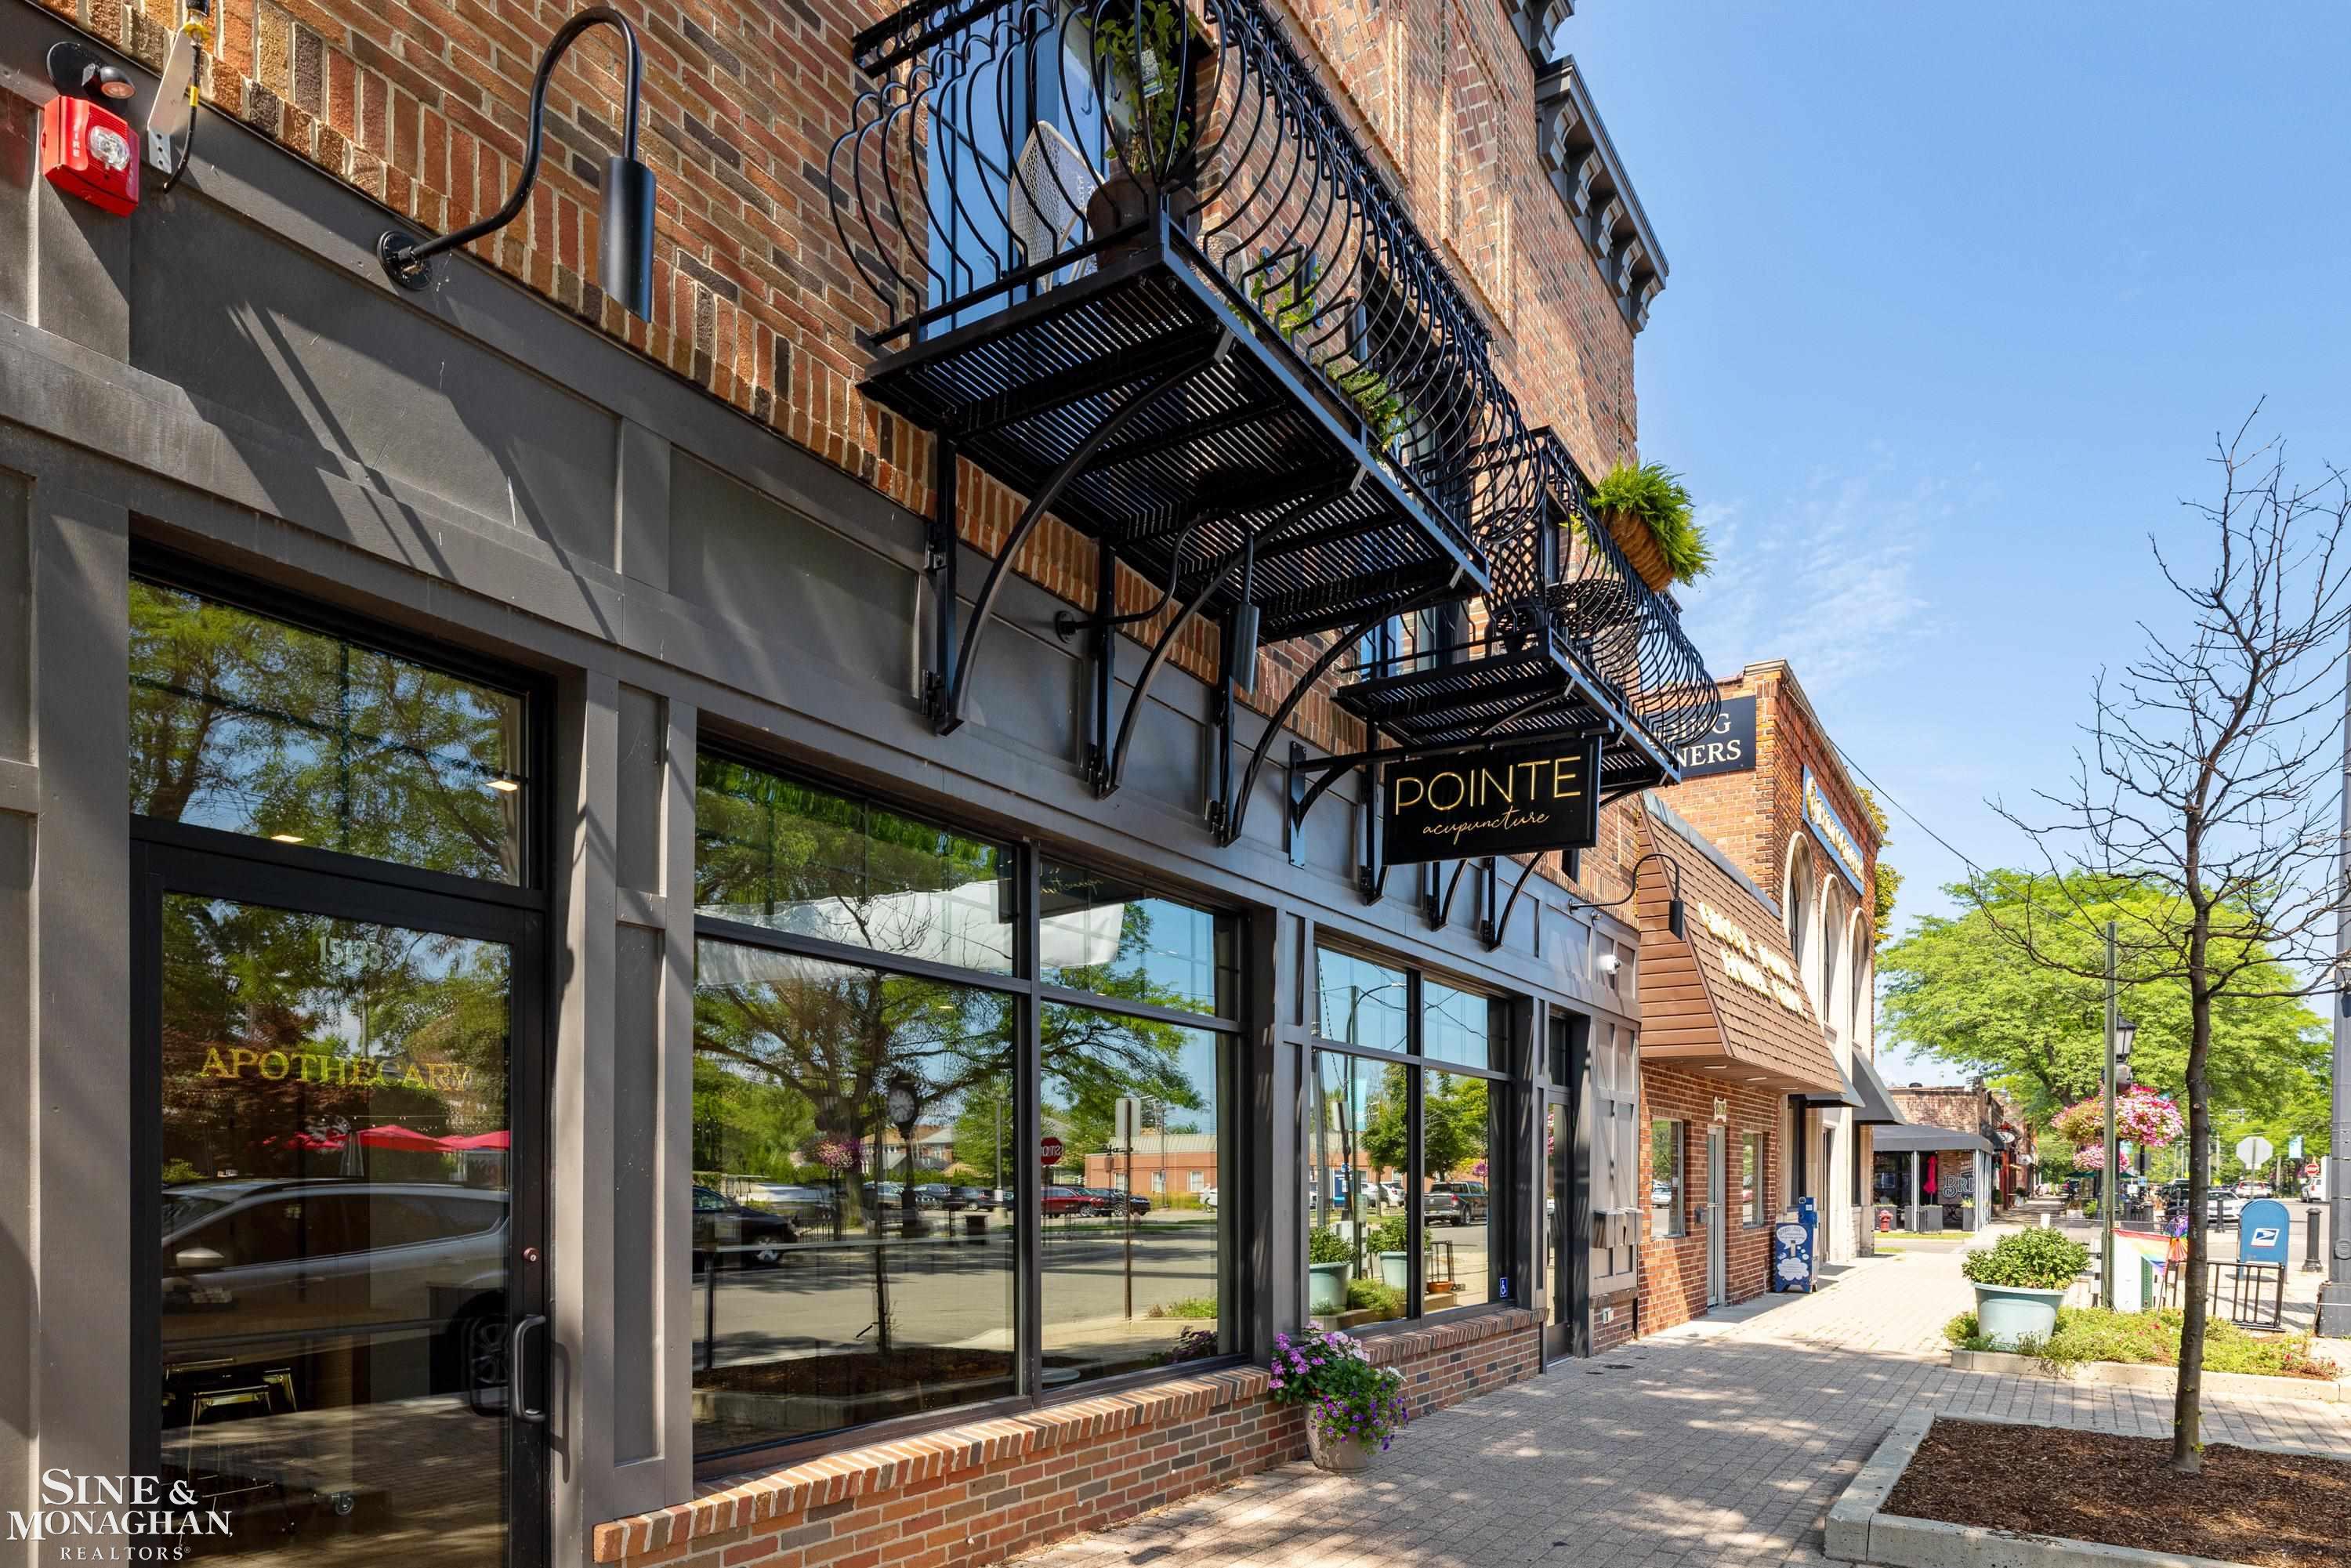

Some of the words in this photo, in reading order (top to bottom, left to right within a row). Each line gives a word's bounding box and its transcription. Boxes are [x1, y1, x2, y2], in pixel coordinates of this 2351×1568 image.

[1672, 740, 1741, 768] NERS
[1396, 755, 1581, 816] POINTE
[1422, 805, 1549, 846] acupuncture
[197, 1046, 470, 1091] APOTHECARY
[1943, 1175, 1975, 1198] BRI
